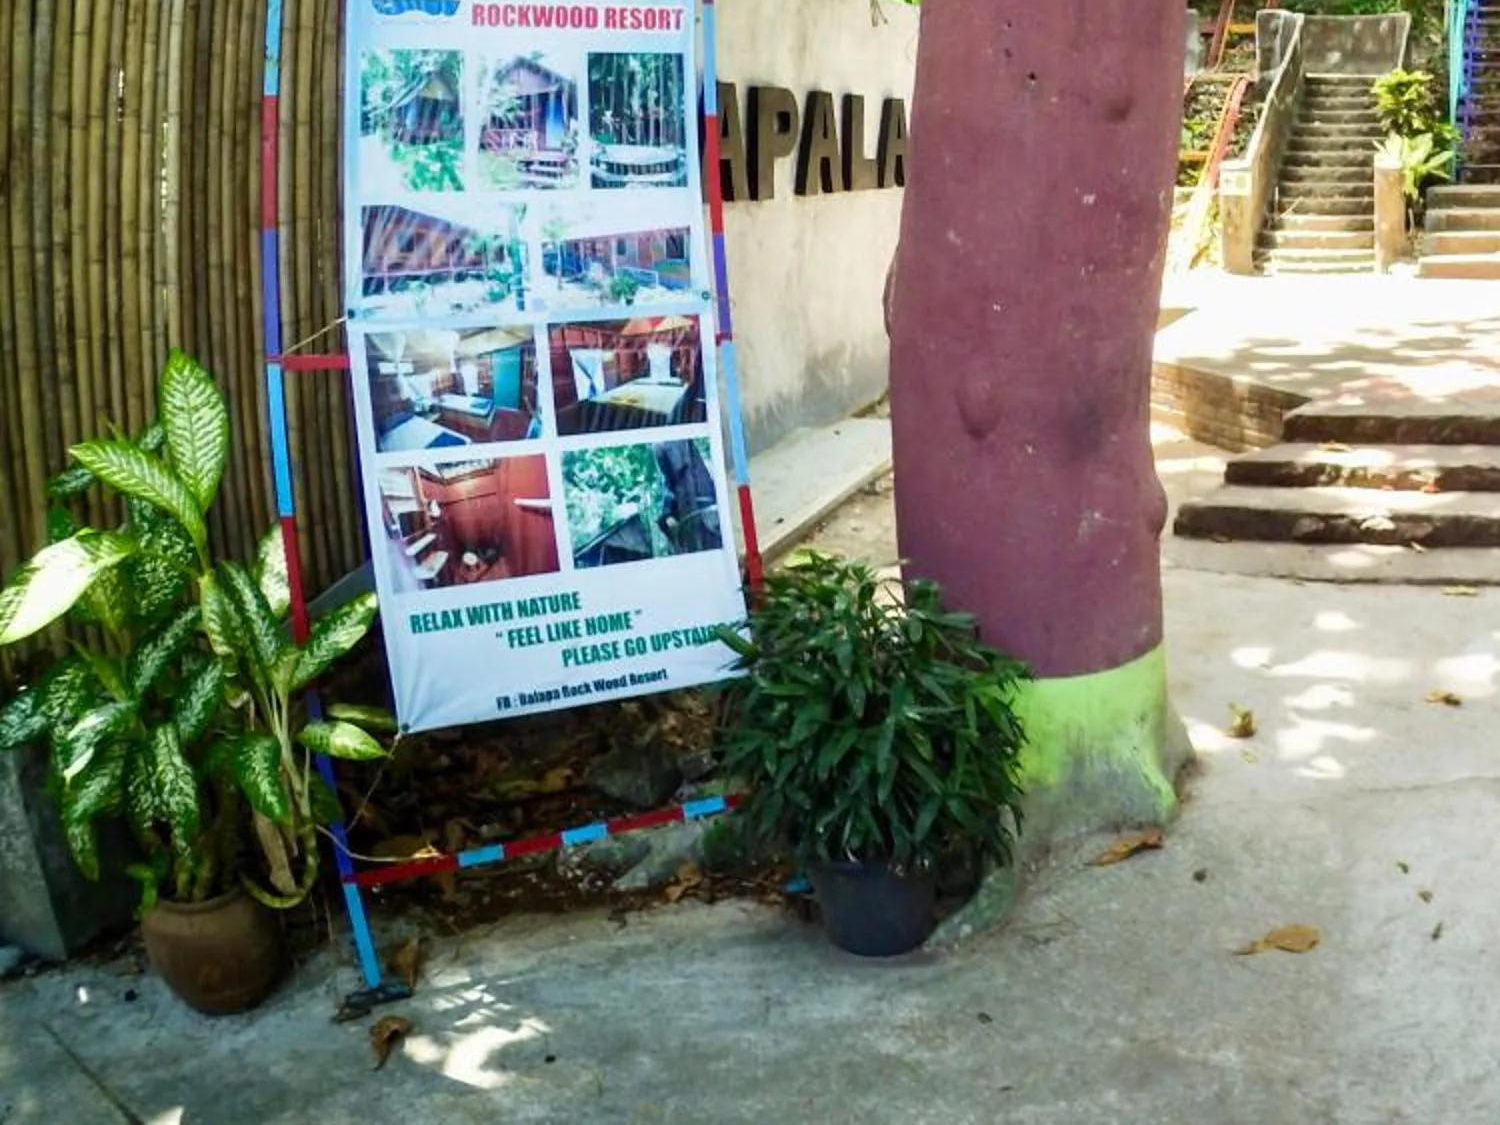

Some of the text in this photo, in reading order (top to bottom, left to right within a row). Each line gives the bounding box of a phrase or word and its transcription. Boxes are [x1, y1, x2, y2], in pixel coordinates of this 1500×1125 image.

[471, 2, 685, 31] ROCKWOOD RESORT
[409, 590, 581, 634] RELAX WITH NATURE
[547, 618, 585, 643] LIKE
[561, 638, 622, 668] PLEASE
[624, 635, 648, 657] GO
[561, 681, 593, 698] Rock
[592, 674, 628, 693] Wood
[629, 667, 668, 686] Resort
